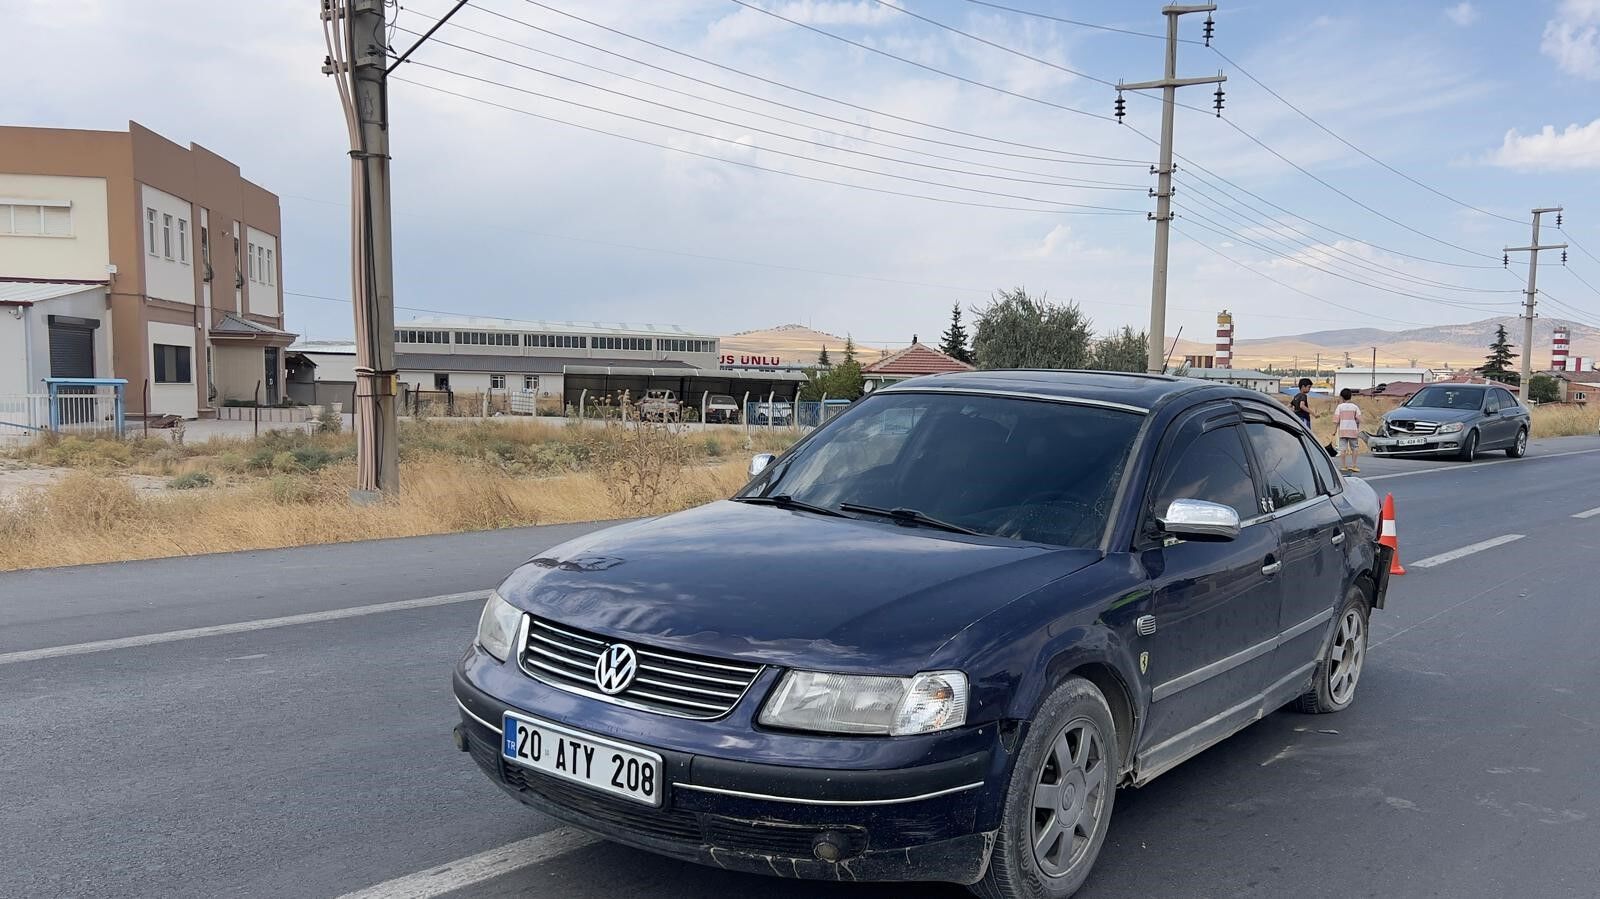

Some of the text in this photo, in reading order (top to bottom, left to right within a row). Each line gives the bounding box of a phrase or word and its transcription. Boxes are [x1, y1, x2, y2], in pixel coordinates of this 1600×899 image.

[741, 355, 780, 366] UNLU
[595, 643, 637, 694] VW
[506, 739, 516, 751] TR
[518, 726, 655, 796] 20 ATY 208
